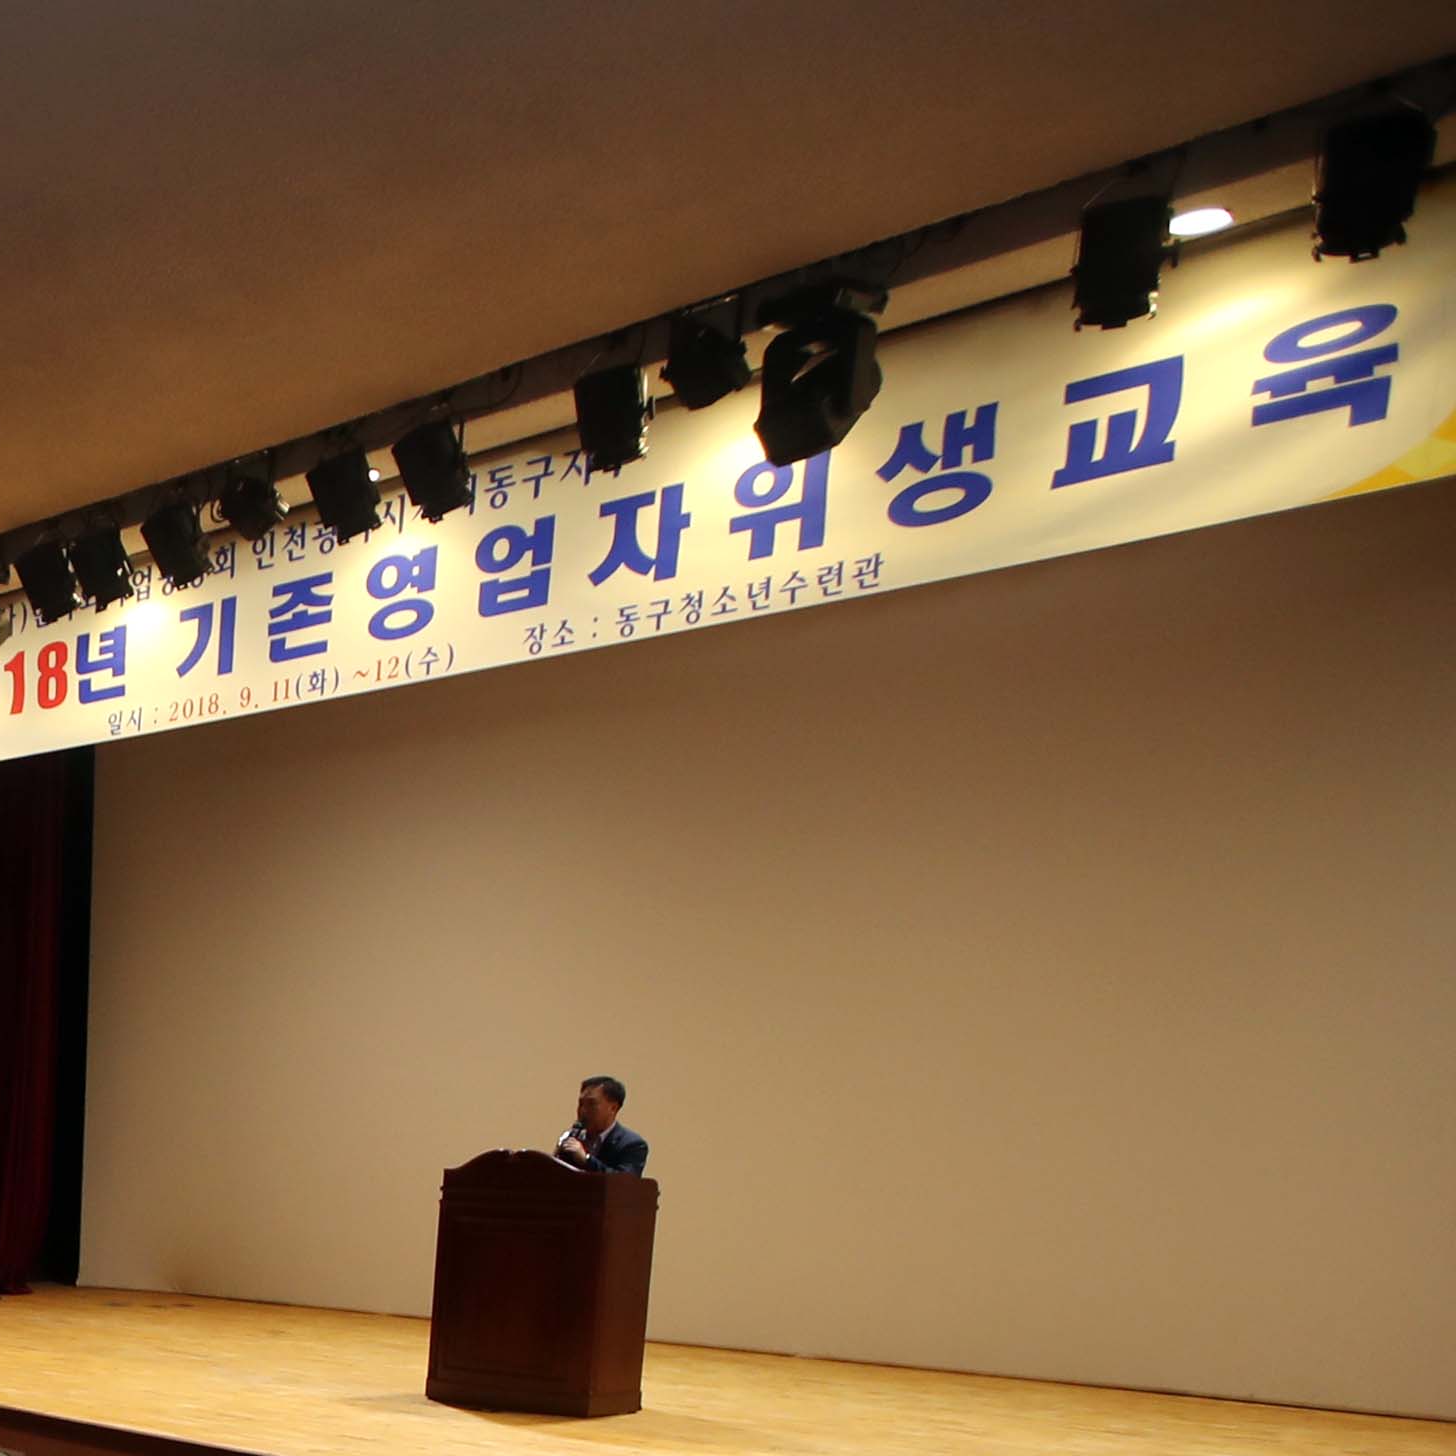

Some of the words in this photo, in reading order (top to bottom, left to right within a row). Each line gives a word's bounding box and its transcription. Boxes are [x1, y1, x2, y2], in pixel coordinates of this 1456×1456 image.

[108, 706, 143, 736] 일시
[169, 692, 227, 722] 2018.
[523, 618, 576, 656] 장소
[614, 552, 885, 639] 동구청소년수련관
